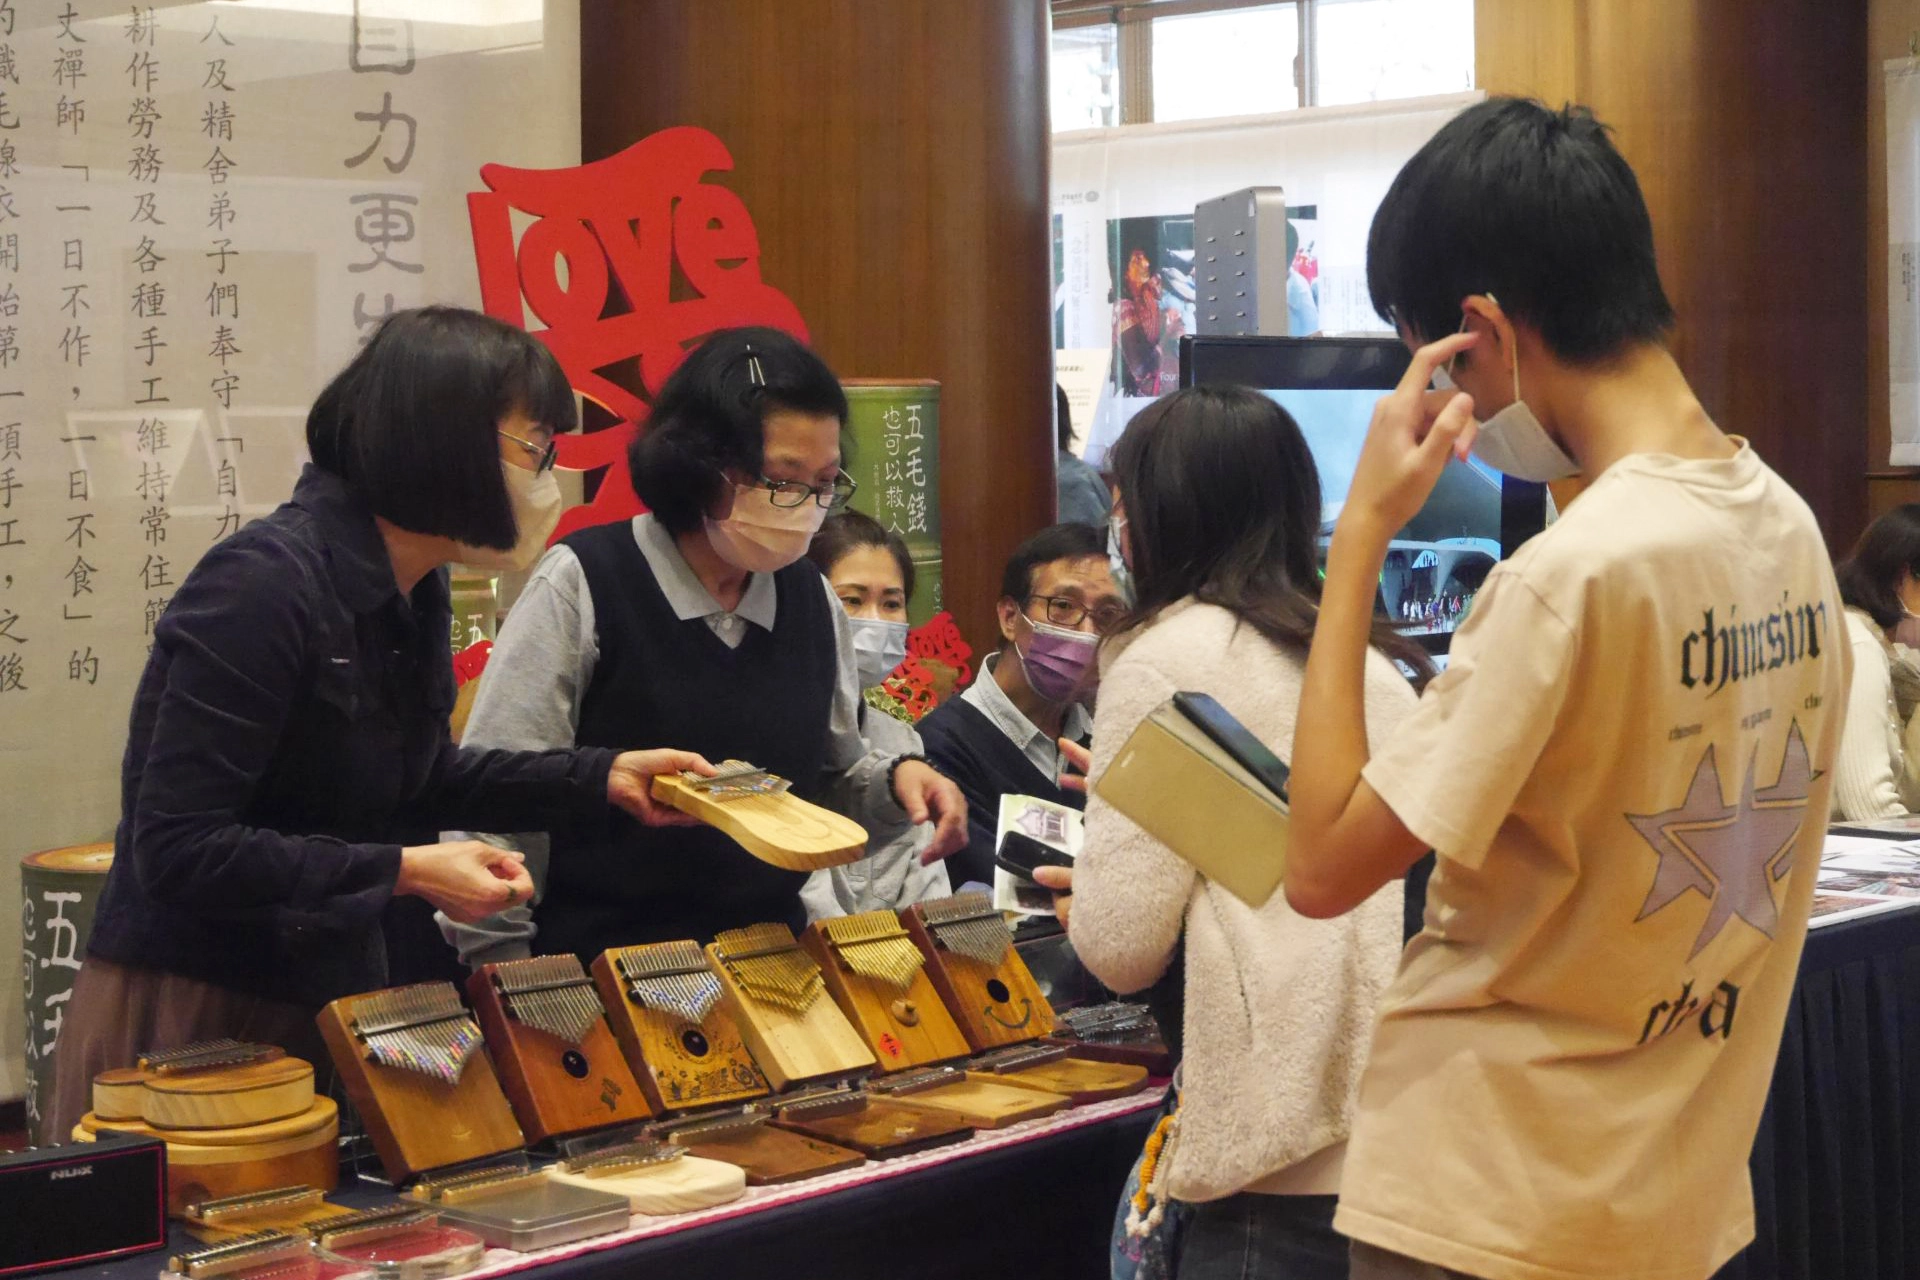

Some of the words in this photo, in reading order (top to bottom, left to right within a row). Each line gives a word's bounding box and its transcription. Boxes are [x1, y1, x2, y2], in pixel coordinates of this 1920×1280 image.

[124, 5, 174, 655] 耕作勞務及各種手工維持常住簡
[905, 404, 927, 533] 五毛錢
